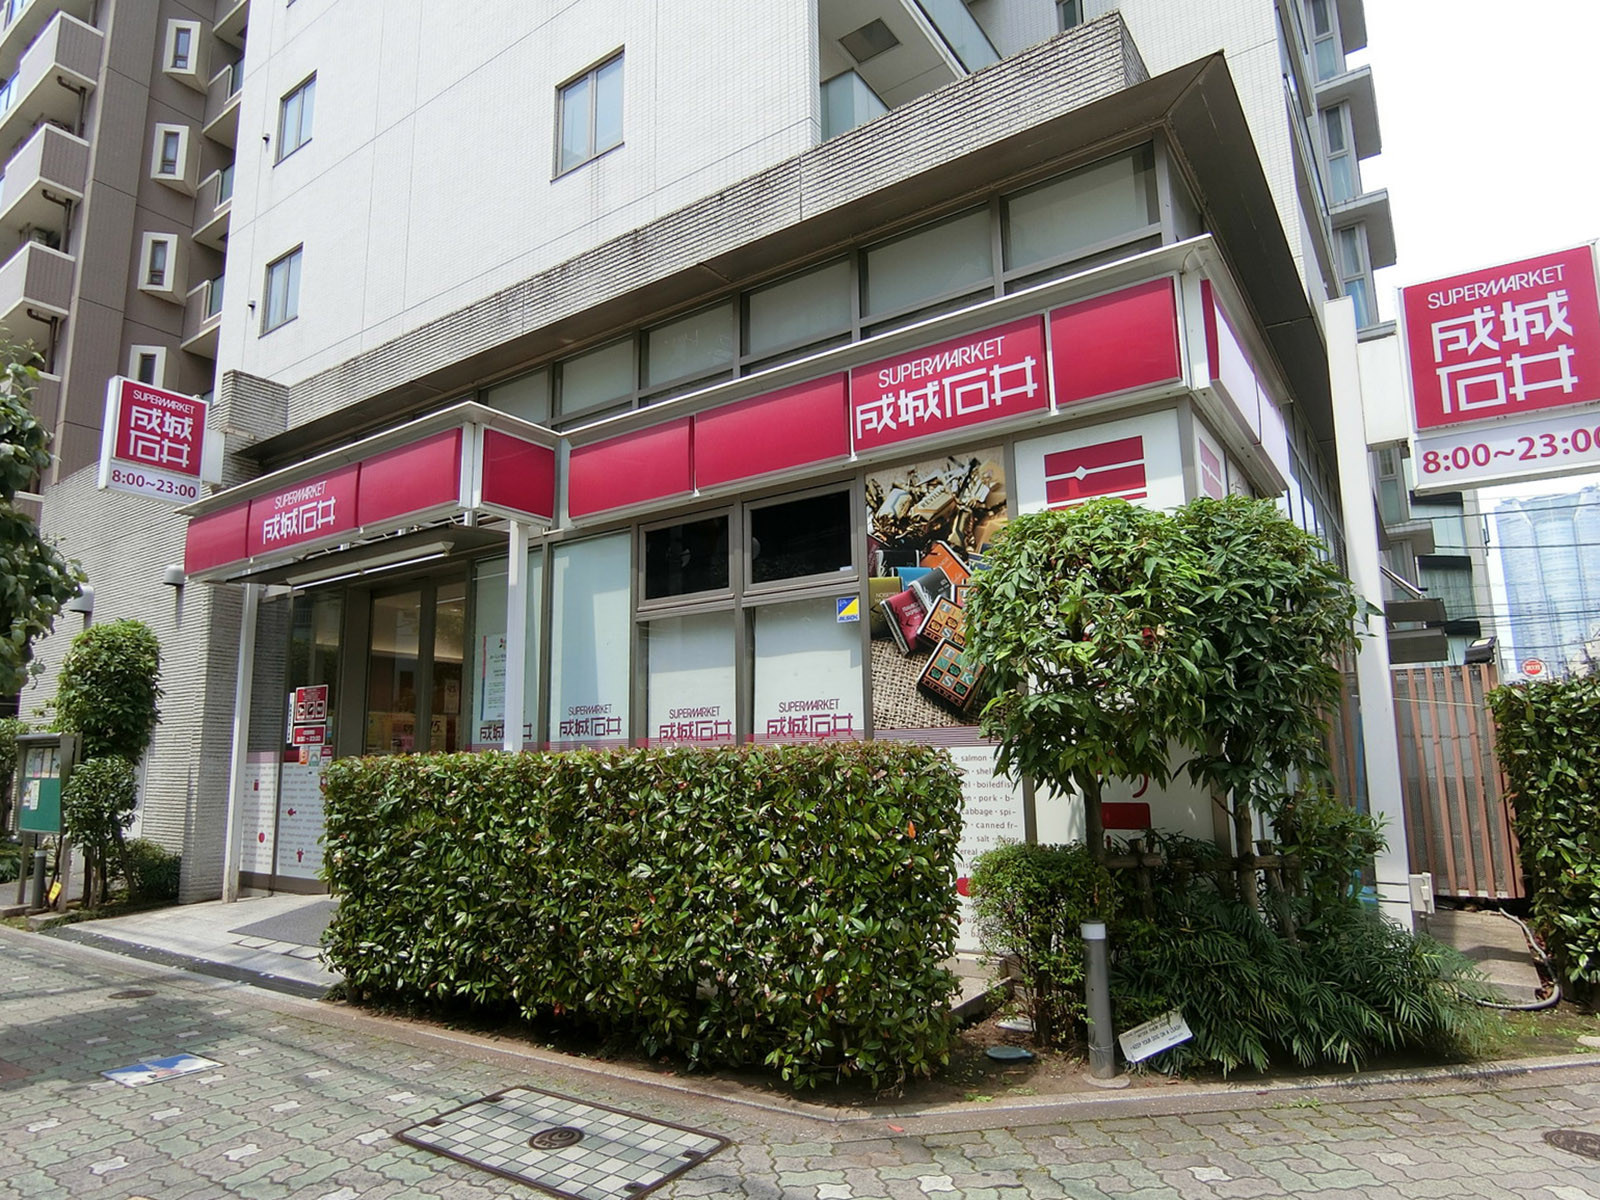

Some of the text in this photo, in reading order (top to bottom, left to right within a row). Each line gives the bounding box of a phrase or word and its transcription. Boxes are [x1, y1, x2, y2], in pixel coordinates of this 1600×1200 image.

[1428, 264, 1565, 310] SUPERMARKET
[1431, 290, 1574, 363] 成城
[878, 336, 1005, 389] SUPERMARKET
[1436, 344, 1579, 414] 石井
[132, 390, 195, 414] SUPERMARKET
[856, 356, 1038, 440] 成城石井
[130, 406, 194, 442] 成城
[129, 432, 190, 468] 石井
[274, 481, 326, 510] SUPERMARKET
[262, 496, 336, 545] 成城石井
[568, 704, 612, 716] SUPERMARKET
[669, 706, 721, 720] SUPERMARKET
[778, 698, 840, 714] SUPERMARKET
[559, 714, 622, 738] 成城石井
[659, 719, 732, 744] 成城石井
[766, 713, 854, 740] 成城石井
